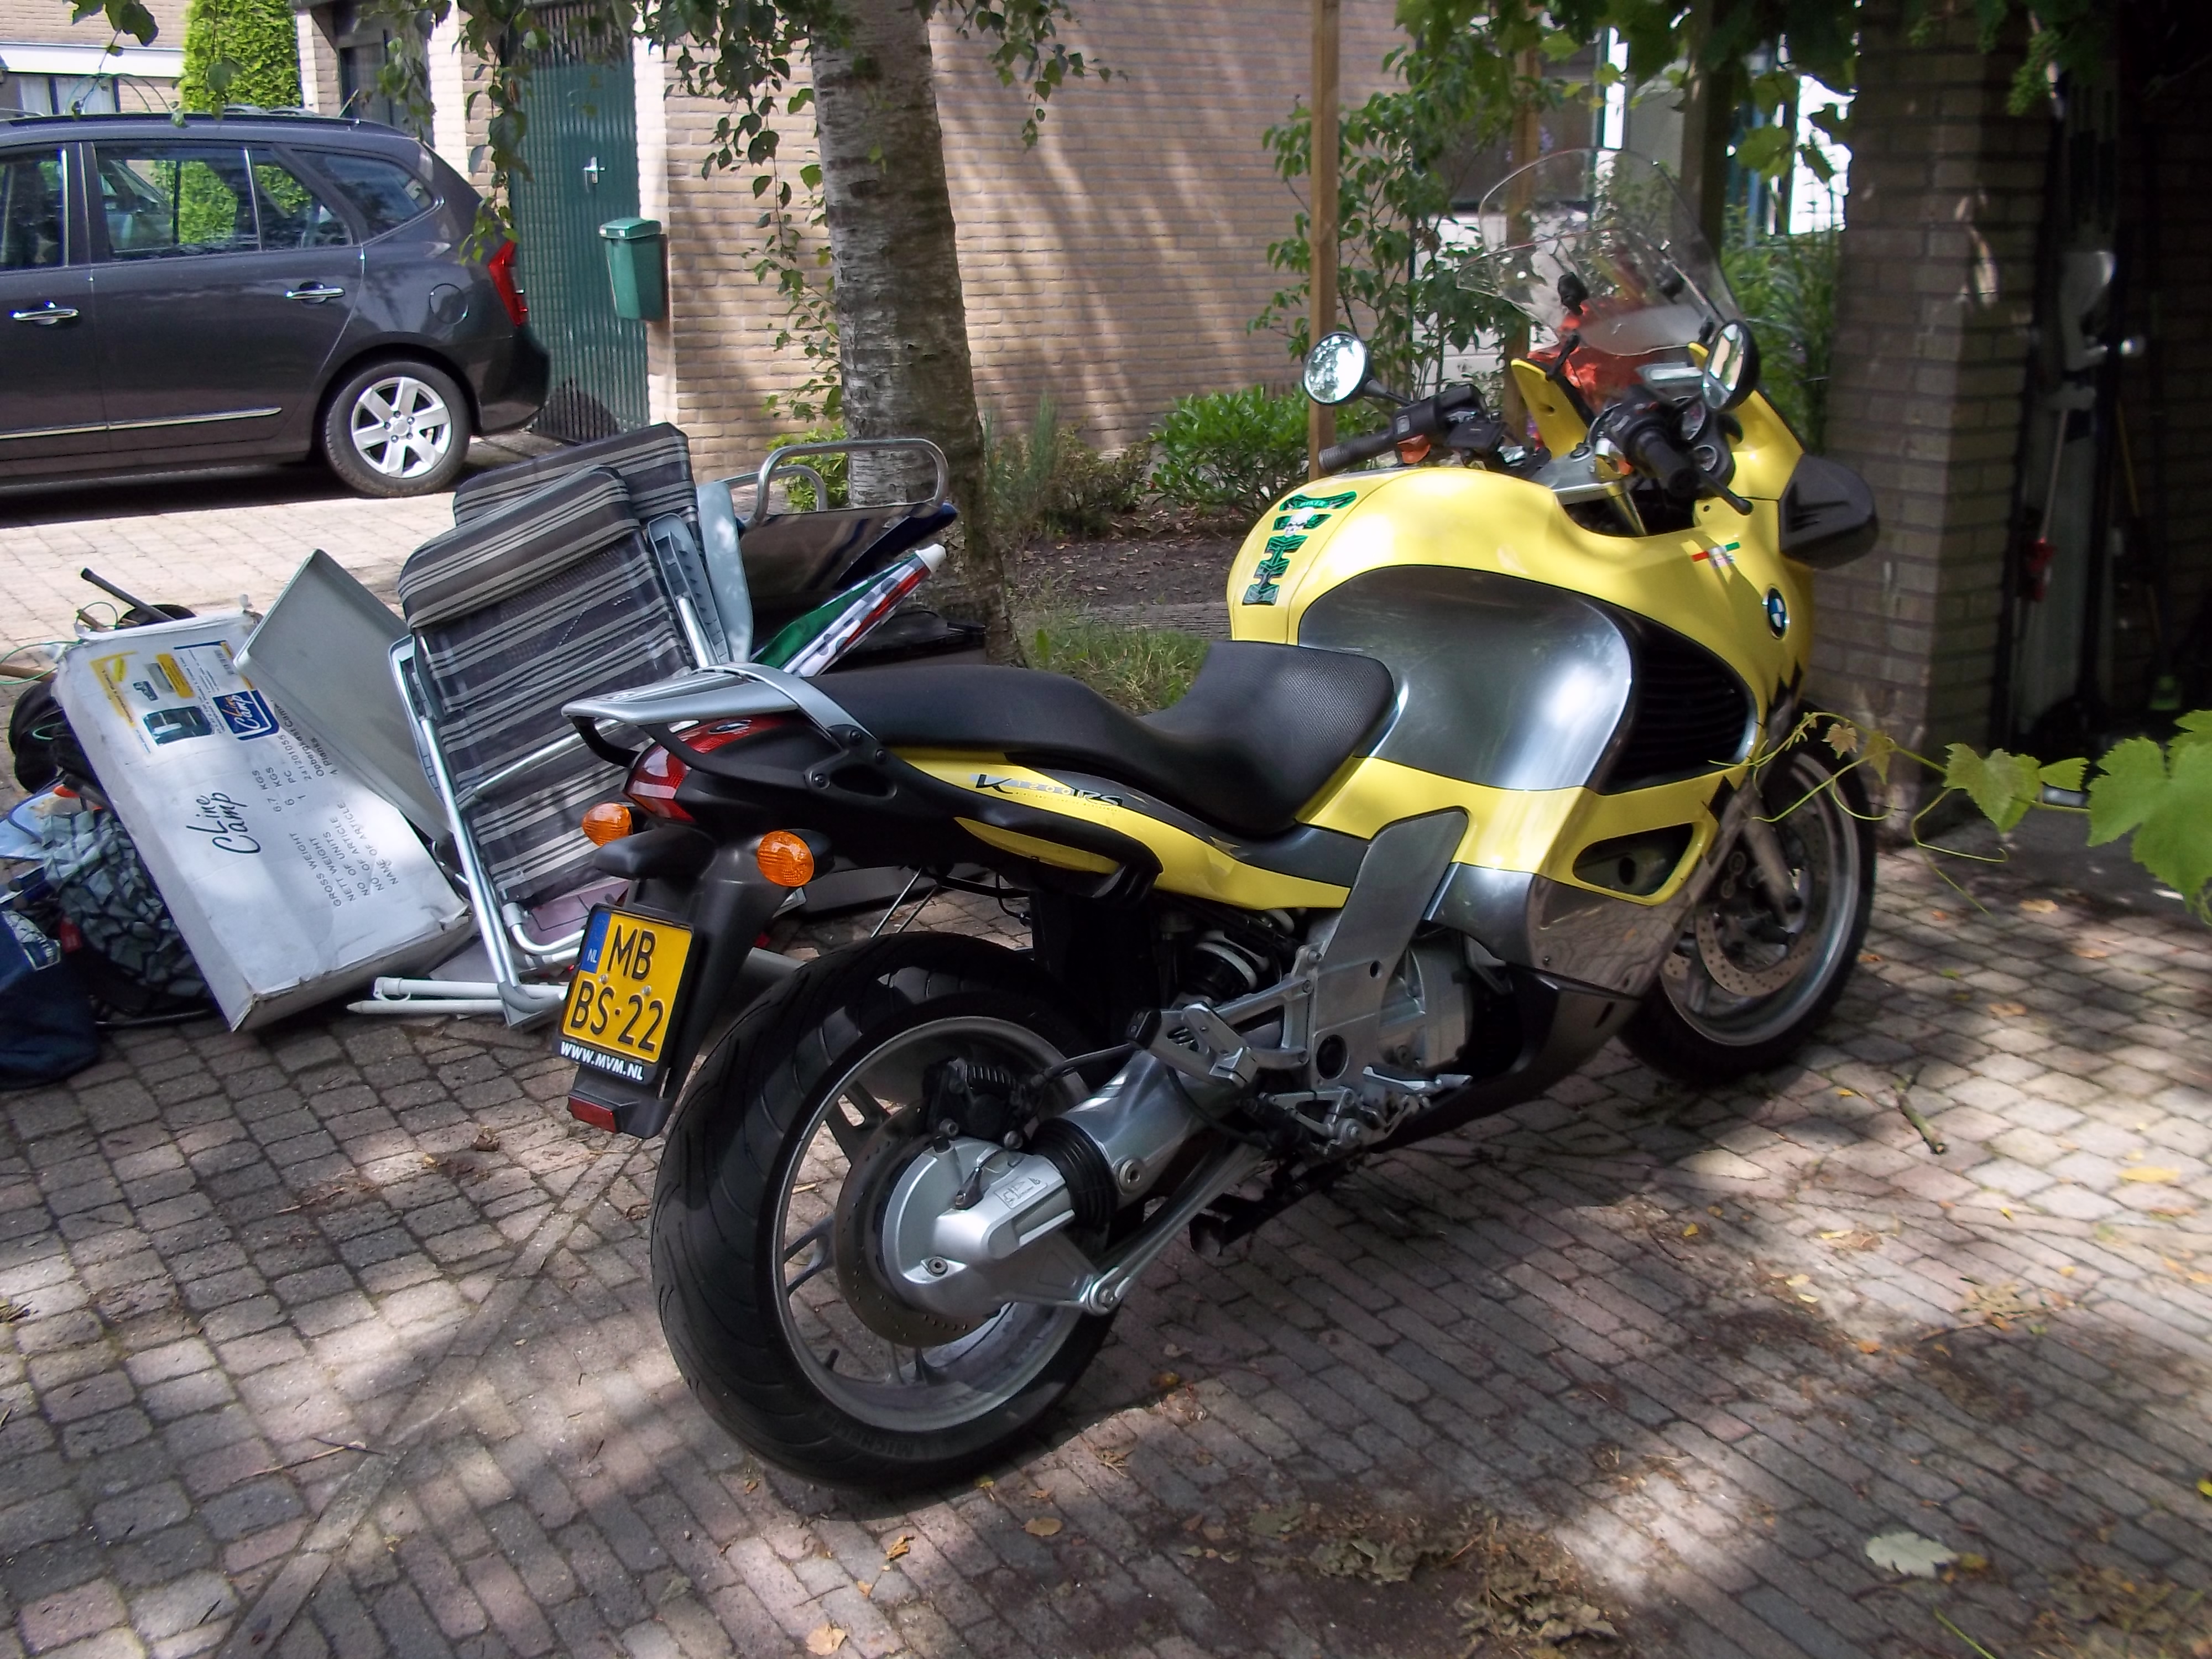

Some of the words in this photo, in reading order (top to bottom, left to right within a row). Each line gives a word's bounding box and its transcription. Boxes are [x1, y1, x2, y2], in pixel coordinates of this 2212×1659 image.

[221, 696, 242, 717] Line
[231, 695, 260, 729] Camp
[252, 770, 269, 790] KGS
[265, 766, 282, 787] KGS
[284, 769, 297, 784] PC
[186, 794, 228, 833] Line
[267, 797, 282, 812] 6.7
[285, 798, 295, 806] 6
[211, 792, 261, 854] Camp
[329, 816, 360, 855] ARTICLE
[289, 832, 318, 870] WEIGHT
[309, 836, 338, 875] WEIGHT
[322, 831, 346, 860] UNITS
[365, 844, 378, 857] OF
[343, 863, 357, 877] OF
[357, 859, 371, 872] OF
[377, 859, 399, 885] NAME
[316, 872, 342, 907] GROSS
[336, 877, 357, 902] NETT
[587, 947, 597, 963] NL
[607, 924, 657, 980] MB
[561, 1041, 644, 1081] WWW.MVM.NL
